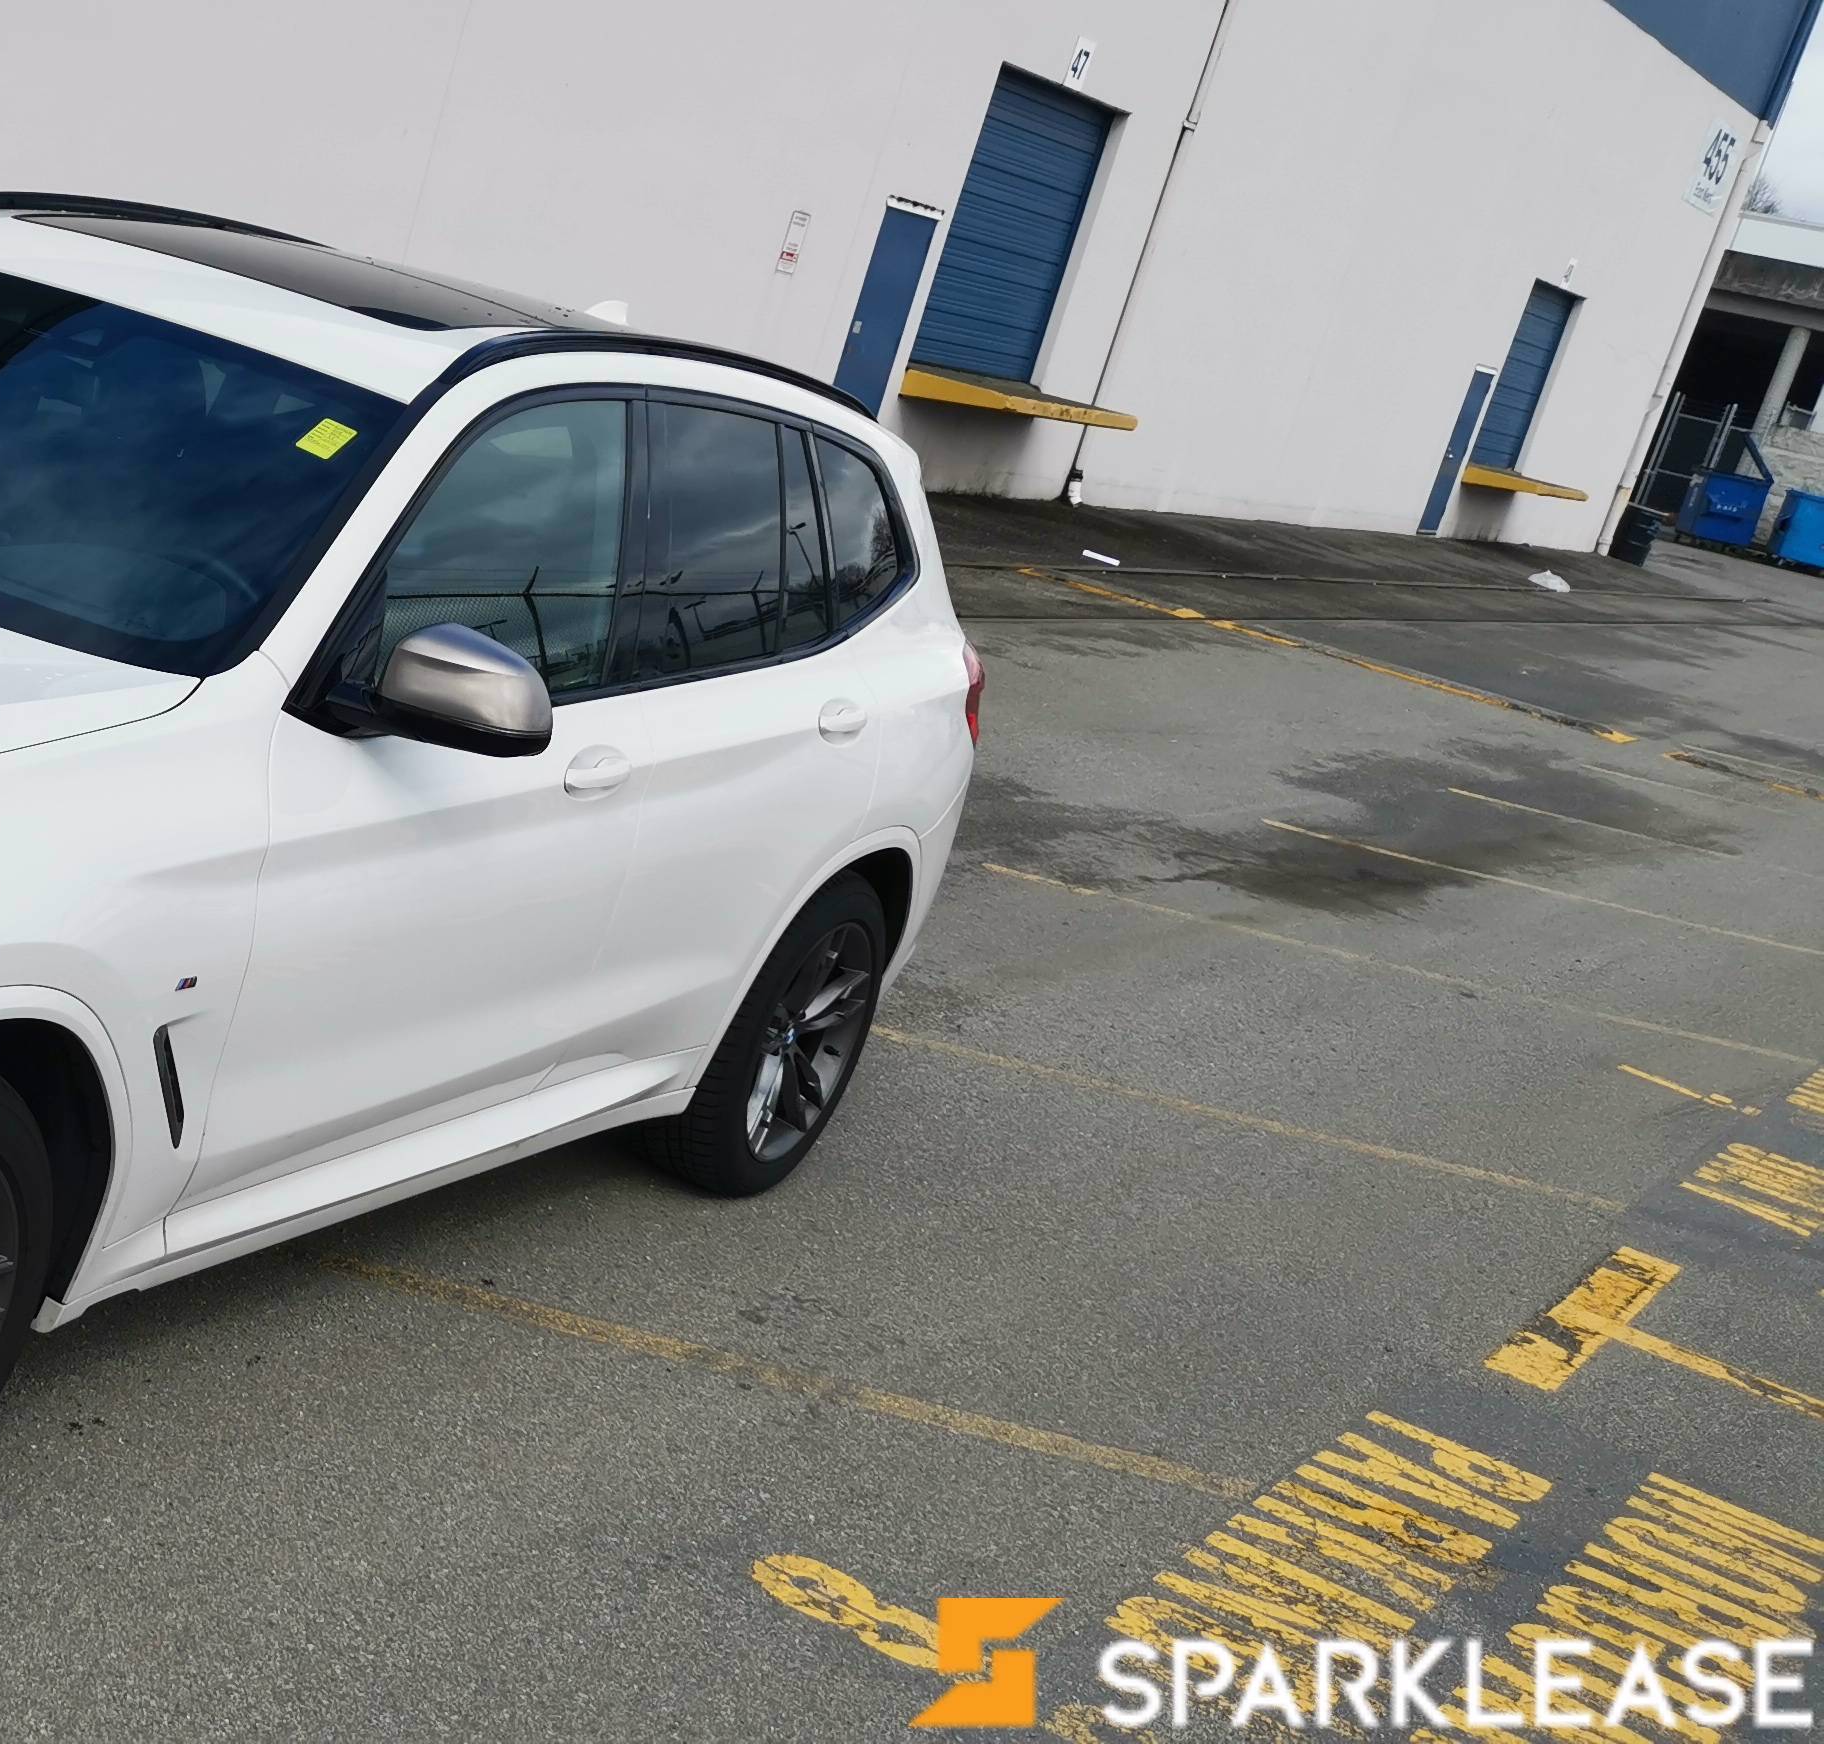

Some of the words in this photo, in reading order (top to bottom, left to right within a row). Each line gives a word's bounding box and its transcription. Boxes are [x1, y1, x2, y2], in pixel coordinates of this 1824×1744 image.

[1071, 48, 1090, 80] 47
[1702, 128, 1736, 185] 455
[1104, 1409, 1554, 1710] PARKING
